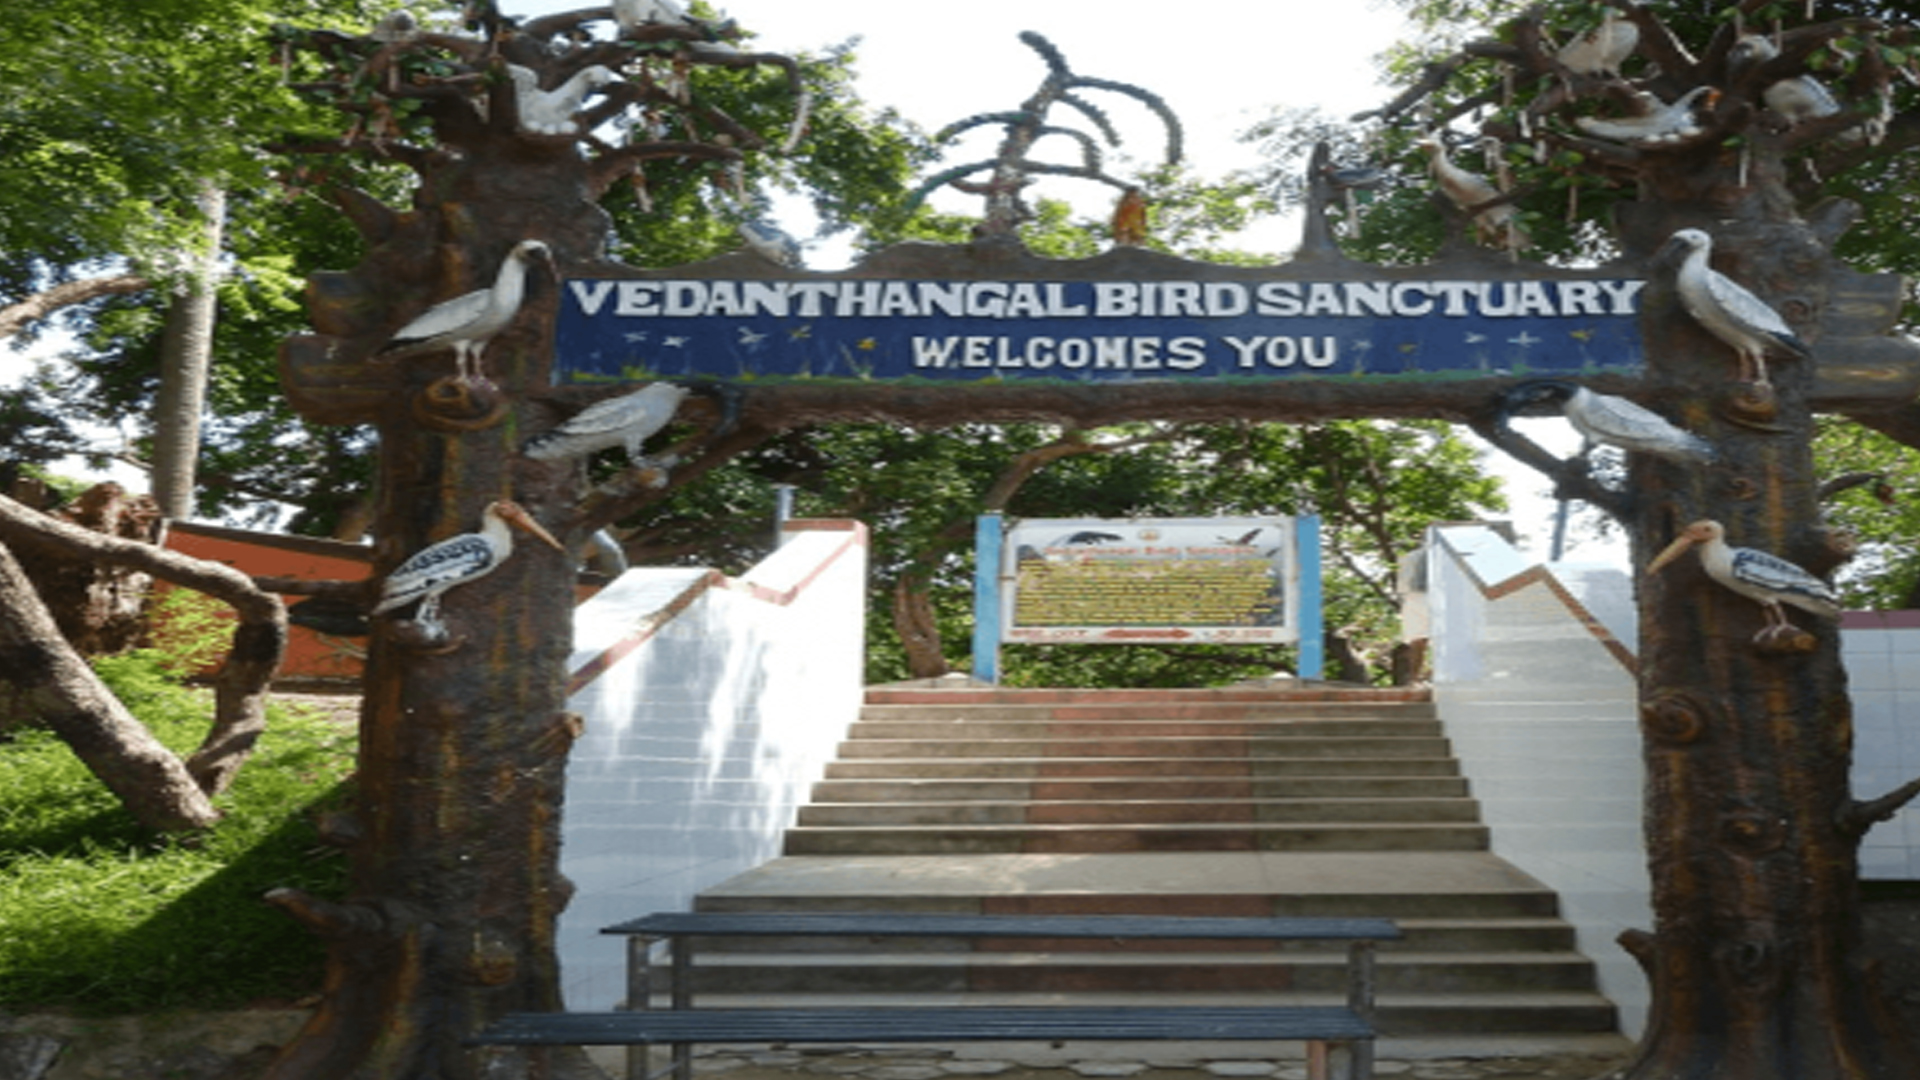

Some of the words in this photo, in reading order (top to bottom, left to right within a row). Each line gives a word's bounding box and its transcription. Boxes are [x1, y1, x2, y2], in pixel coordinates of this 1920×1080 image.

[570, 281, 1087, 317] VEDANTHANGAL
[1096, 281, 1248, 317] BIRD
[1257, 281, 1647, 317] SANCTUARY
[912, 336, 1206, 369] WELCOMES
[1223, 335, 1337, 368] YOU
